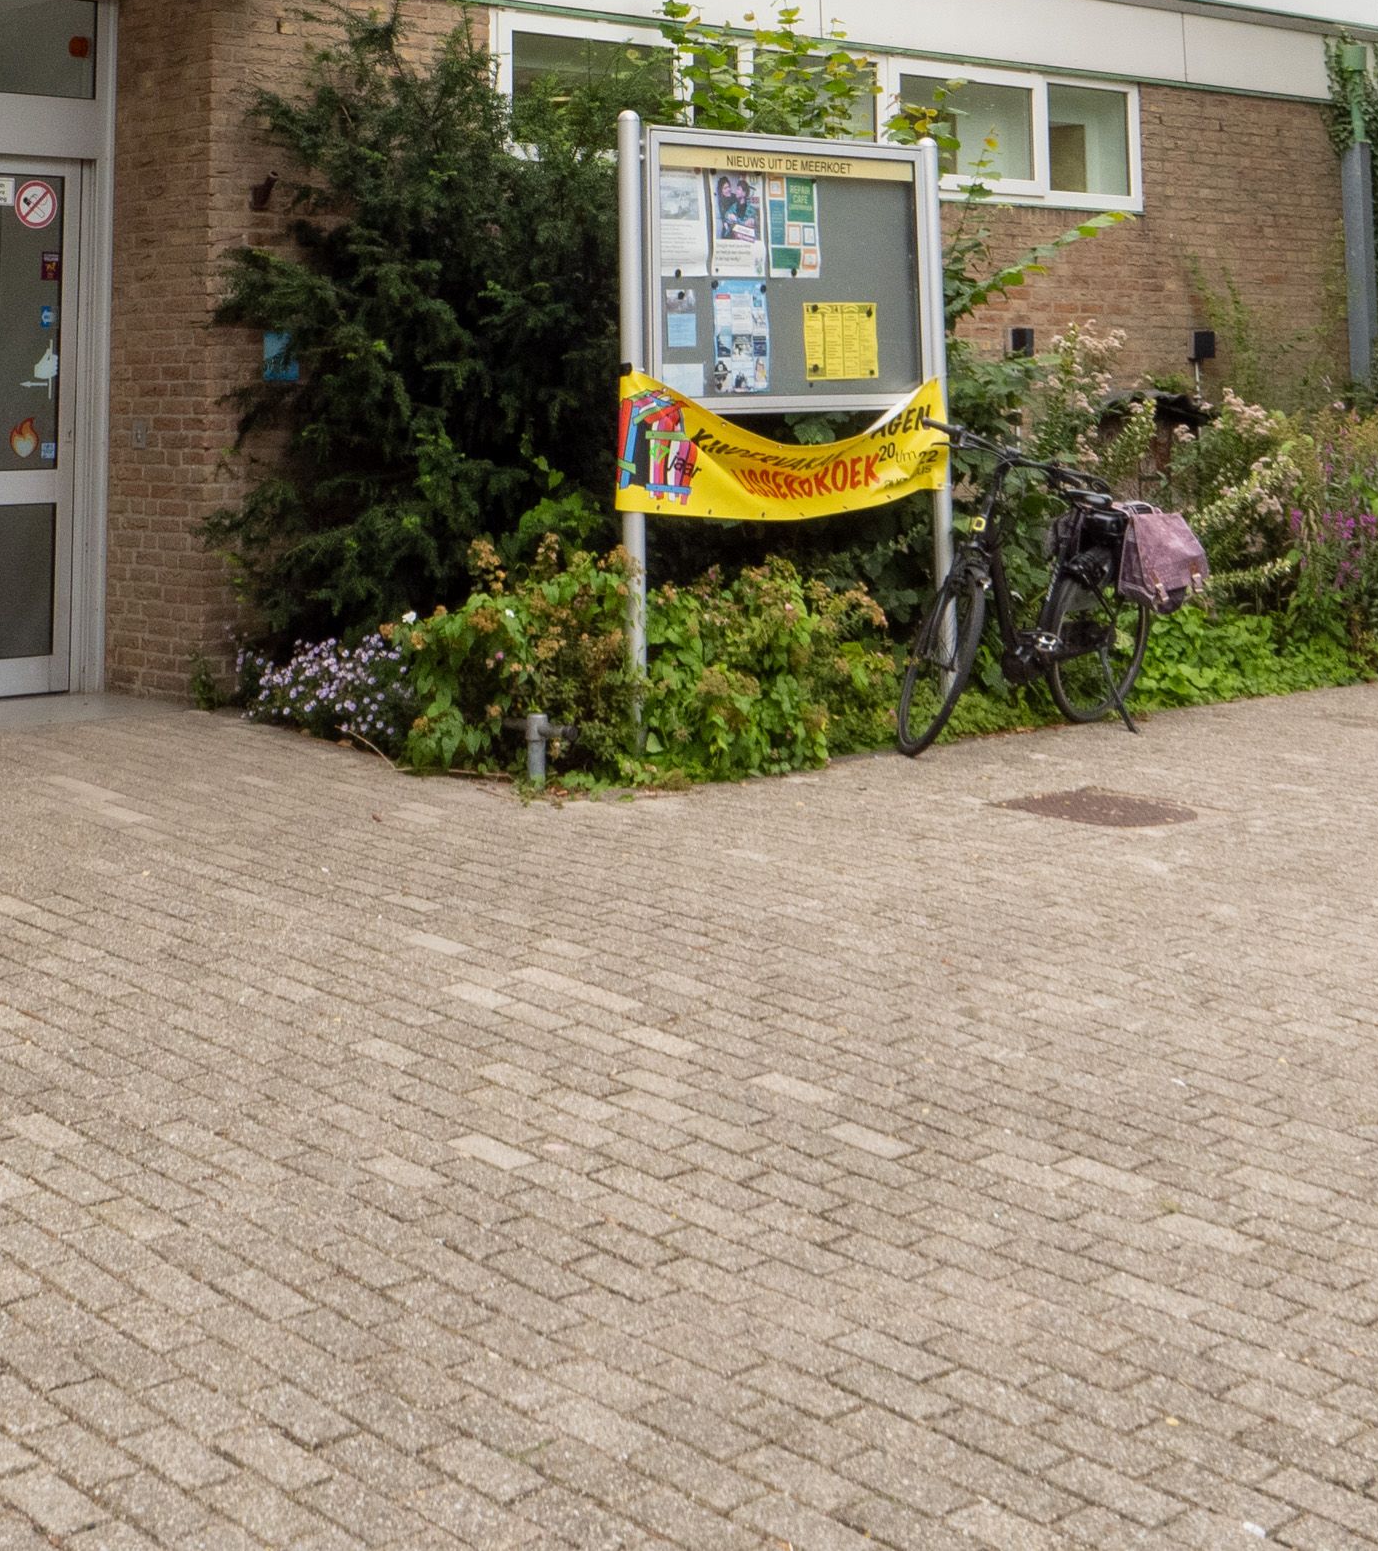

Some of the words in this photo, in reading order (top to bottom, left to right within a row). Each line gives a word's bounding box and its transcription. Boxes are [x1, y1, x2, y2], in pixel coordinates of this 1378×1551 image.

[726, 155, 766, 169] NIEUWS
[768, 158, 783, 170] UIT
[786, 159, 798, 171] DE
[801, 161, 852, 174] MEERKOET
[878, 442, 895, 462] 20
[667, 452, 702, 479] jaar
